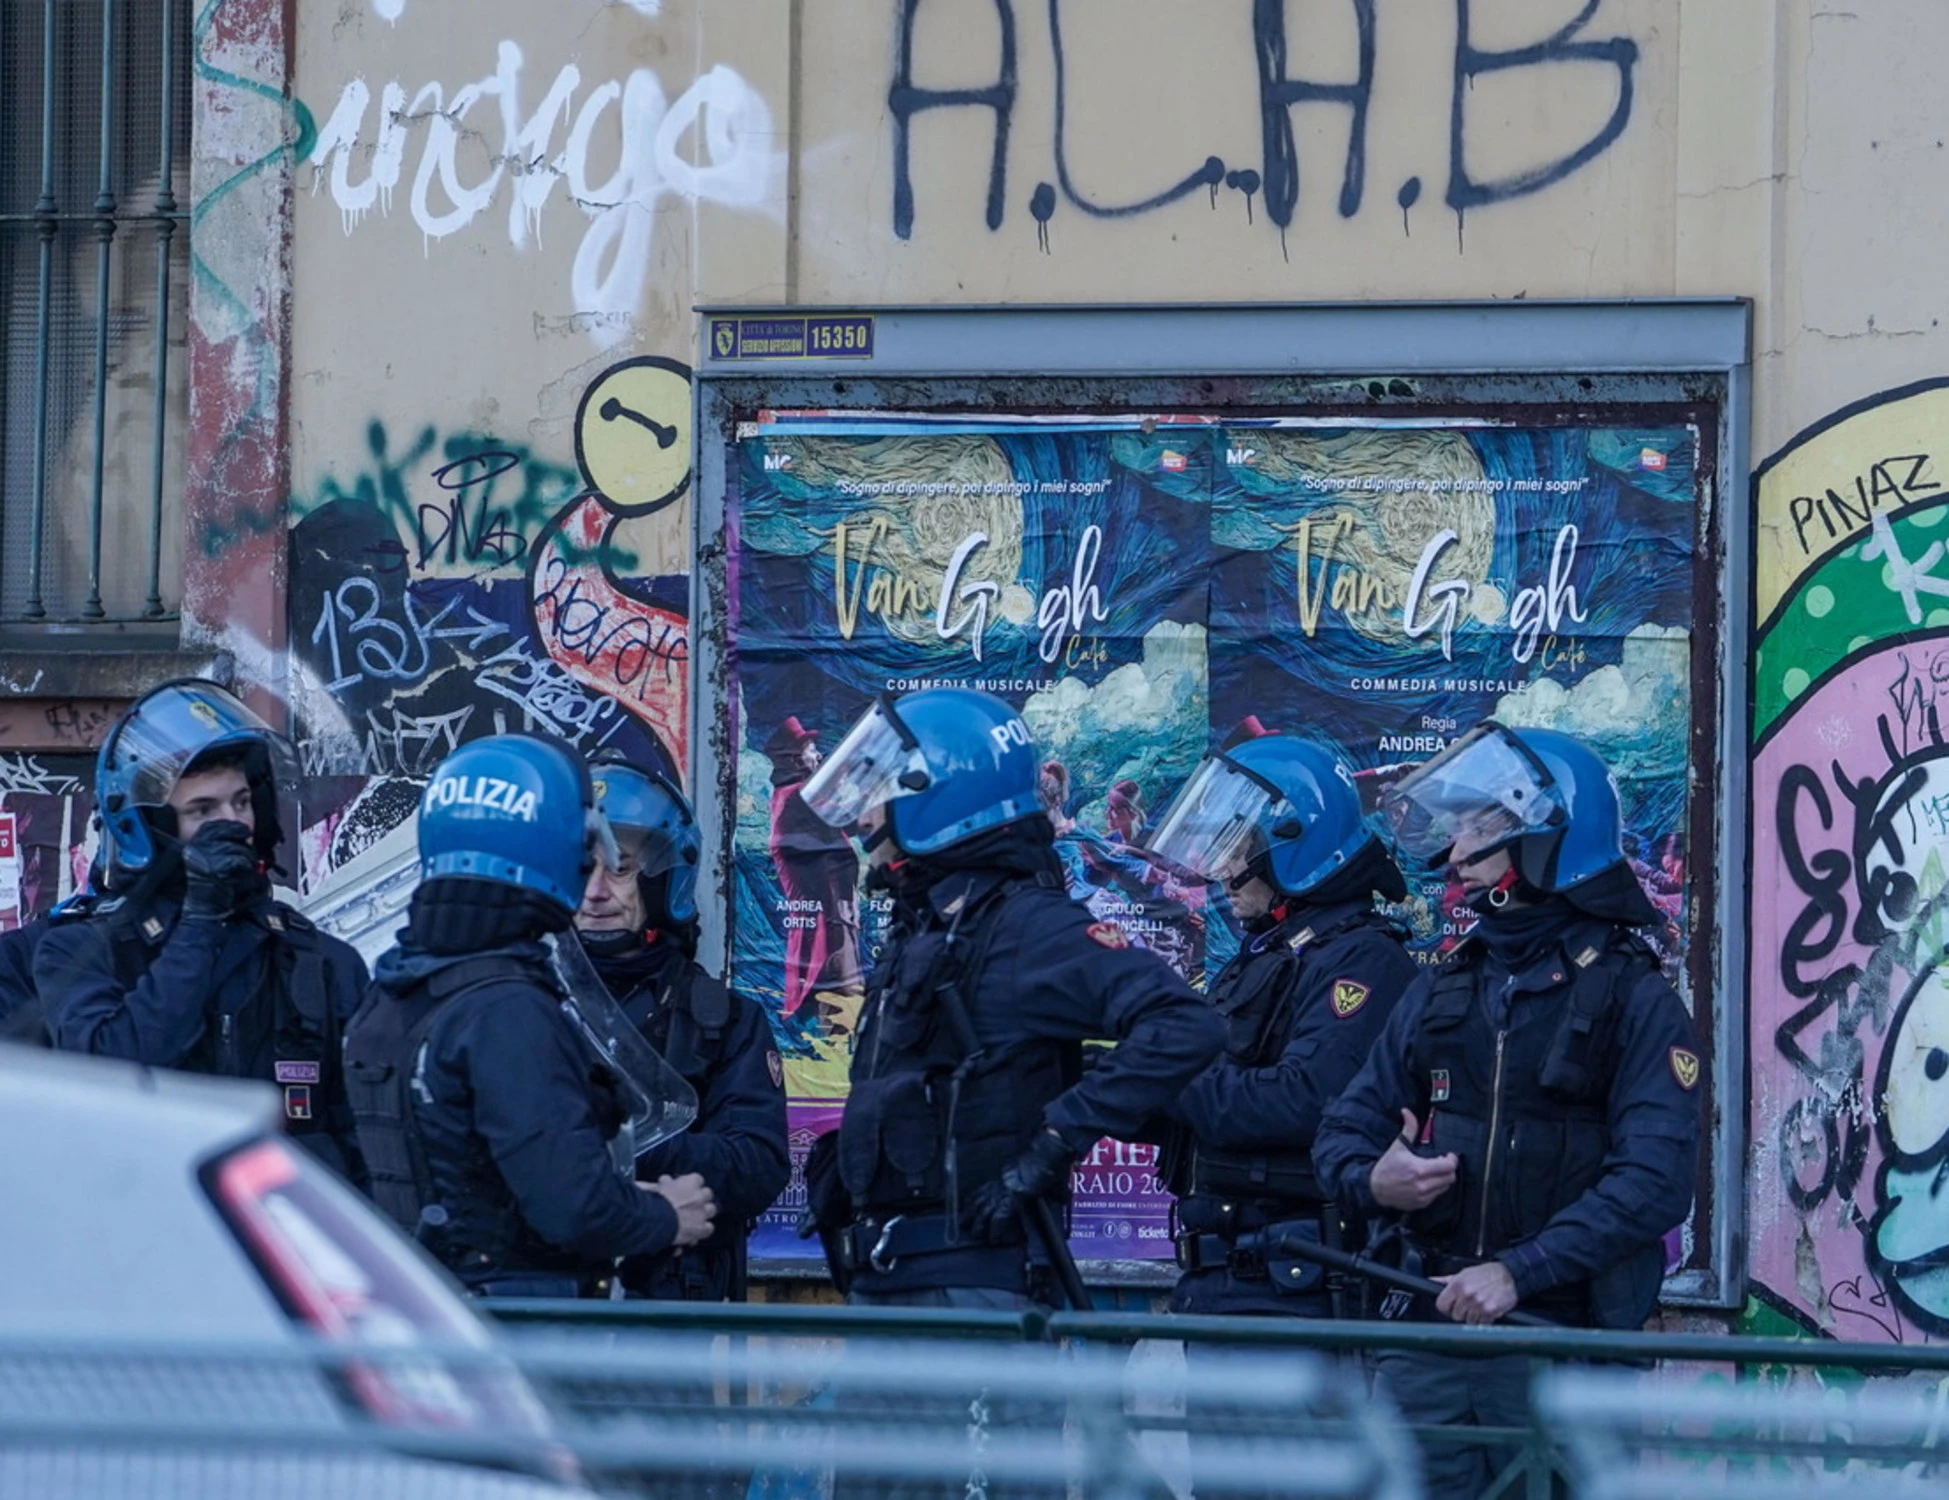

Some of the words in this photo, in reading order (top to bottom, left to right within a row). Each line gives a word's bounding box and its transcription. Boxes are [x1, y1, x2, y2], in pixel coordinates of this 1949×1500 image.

[811, 326, 867, 348] 15350
[883, 480, 896, 494] di
[896, 480, 960, 497] dipingere,
[963, 481, 981, 496] poi
[984, 480, 1031, 496] dipingo
[1041, 480, 1067, 493] miei
[1347, 476, 1361, 490] di
[1363, 476, 1428, 492] dipingere,
[1431, 477, 1449, 493] poi
[1453, 477, 1503, 494] dipingo
[1514, 477, 1542, 491] miei
[1790, 454, 1942, 555] PINAZ
[835, 516, 930, 640] Van
[1297, 513, 1396, 637] Van
[1065, 634, 1110, 669] Café
[1541, 635, 1587, 671] Café
[887, 679, 968, 691] COMMEDIA
[975, 679, 1055, 691] MUSICALE
[1350, 678, 1437, 692] COMMEDIA
[1444, 679, 1528, 693] MUSICALE
[1421, 715, 1457, 732] Regia
[1378, 735, 1446, 752] ANDREA
[424, 775, 537, 822] POLIZIA
[1421, 885, 1443, 895] con
[776, 900, 823, 912] ANDREA
[870, 900, 894, 912] FLO
[1104, 903, 1145, 915] GIULIO
[1371, 903, 1394, 916] NA
[783, 917, 817, 929] ORTIS
[1443, 923, 1457, 935] DI
[1072, 1172, 1133, 1195] RAIO
[1140, 1173, 1166, 1195] 20
